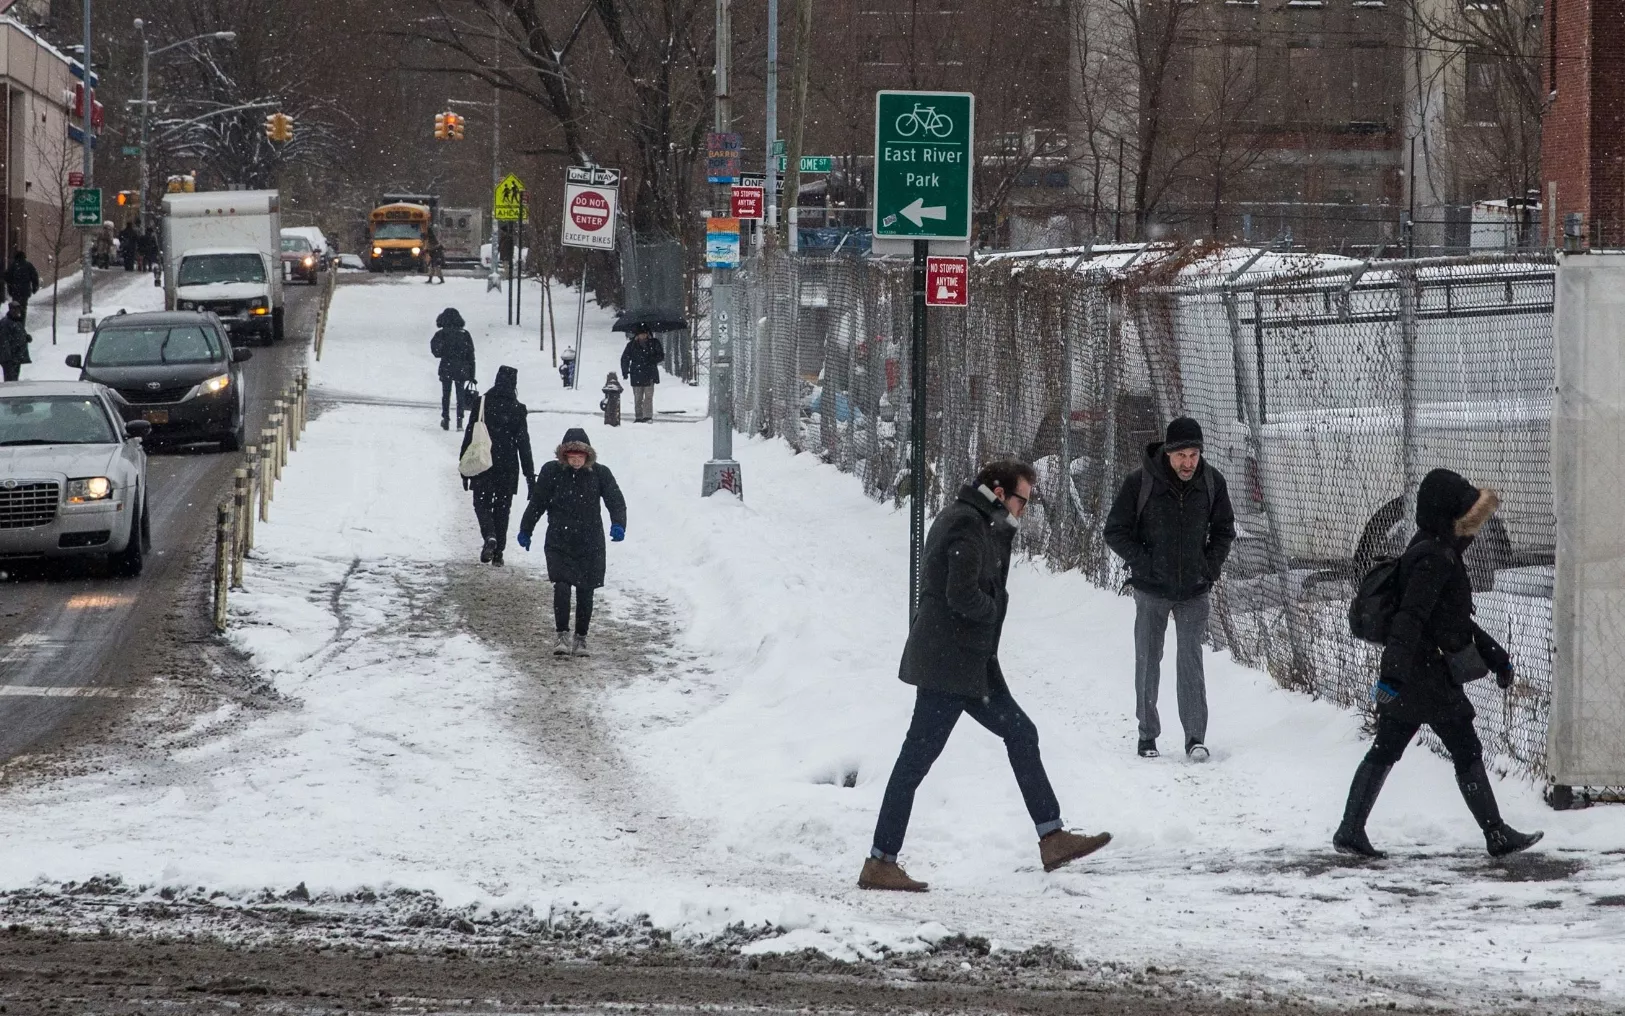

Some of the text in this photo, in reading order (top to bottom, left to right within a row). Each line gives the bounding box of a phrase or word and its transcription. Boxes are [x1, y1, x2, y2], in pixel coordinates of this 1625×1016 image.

[708, 150, 739, 158] BARRIO
[884, 147, 963, 164] East River
[571, 172, 614, 181] ONE WAY
[905, 172, 940, 188] Park
[740, 190, 761, 198] STOPPING
[575, 196, 606, 207] DO NOT
[576, 215, 603, 226] ENTER
[565, 232, 611, 245] EXCEPT BIKES
[930, 263, 964, 274] NO STOPPING
[935, 277, 959, 287] ANYTIME
